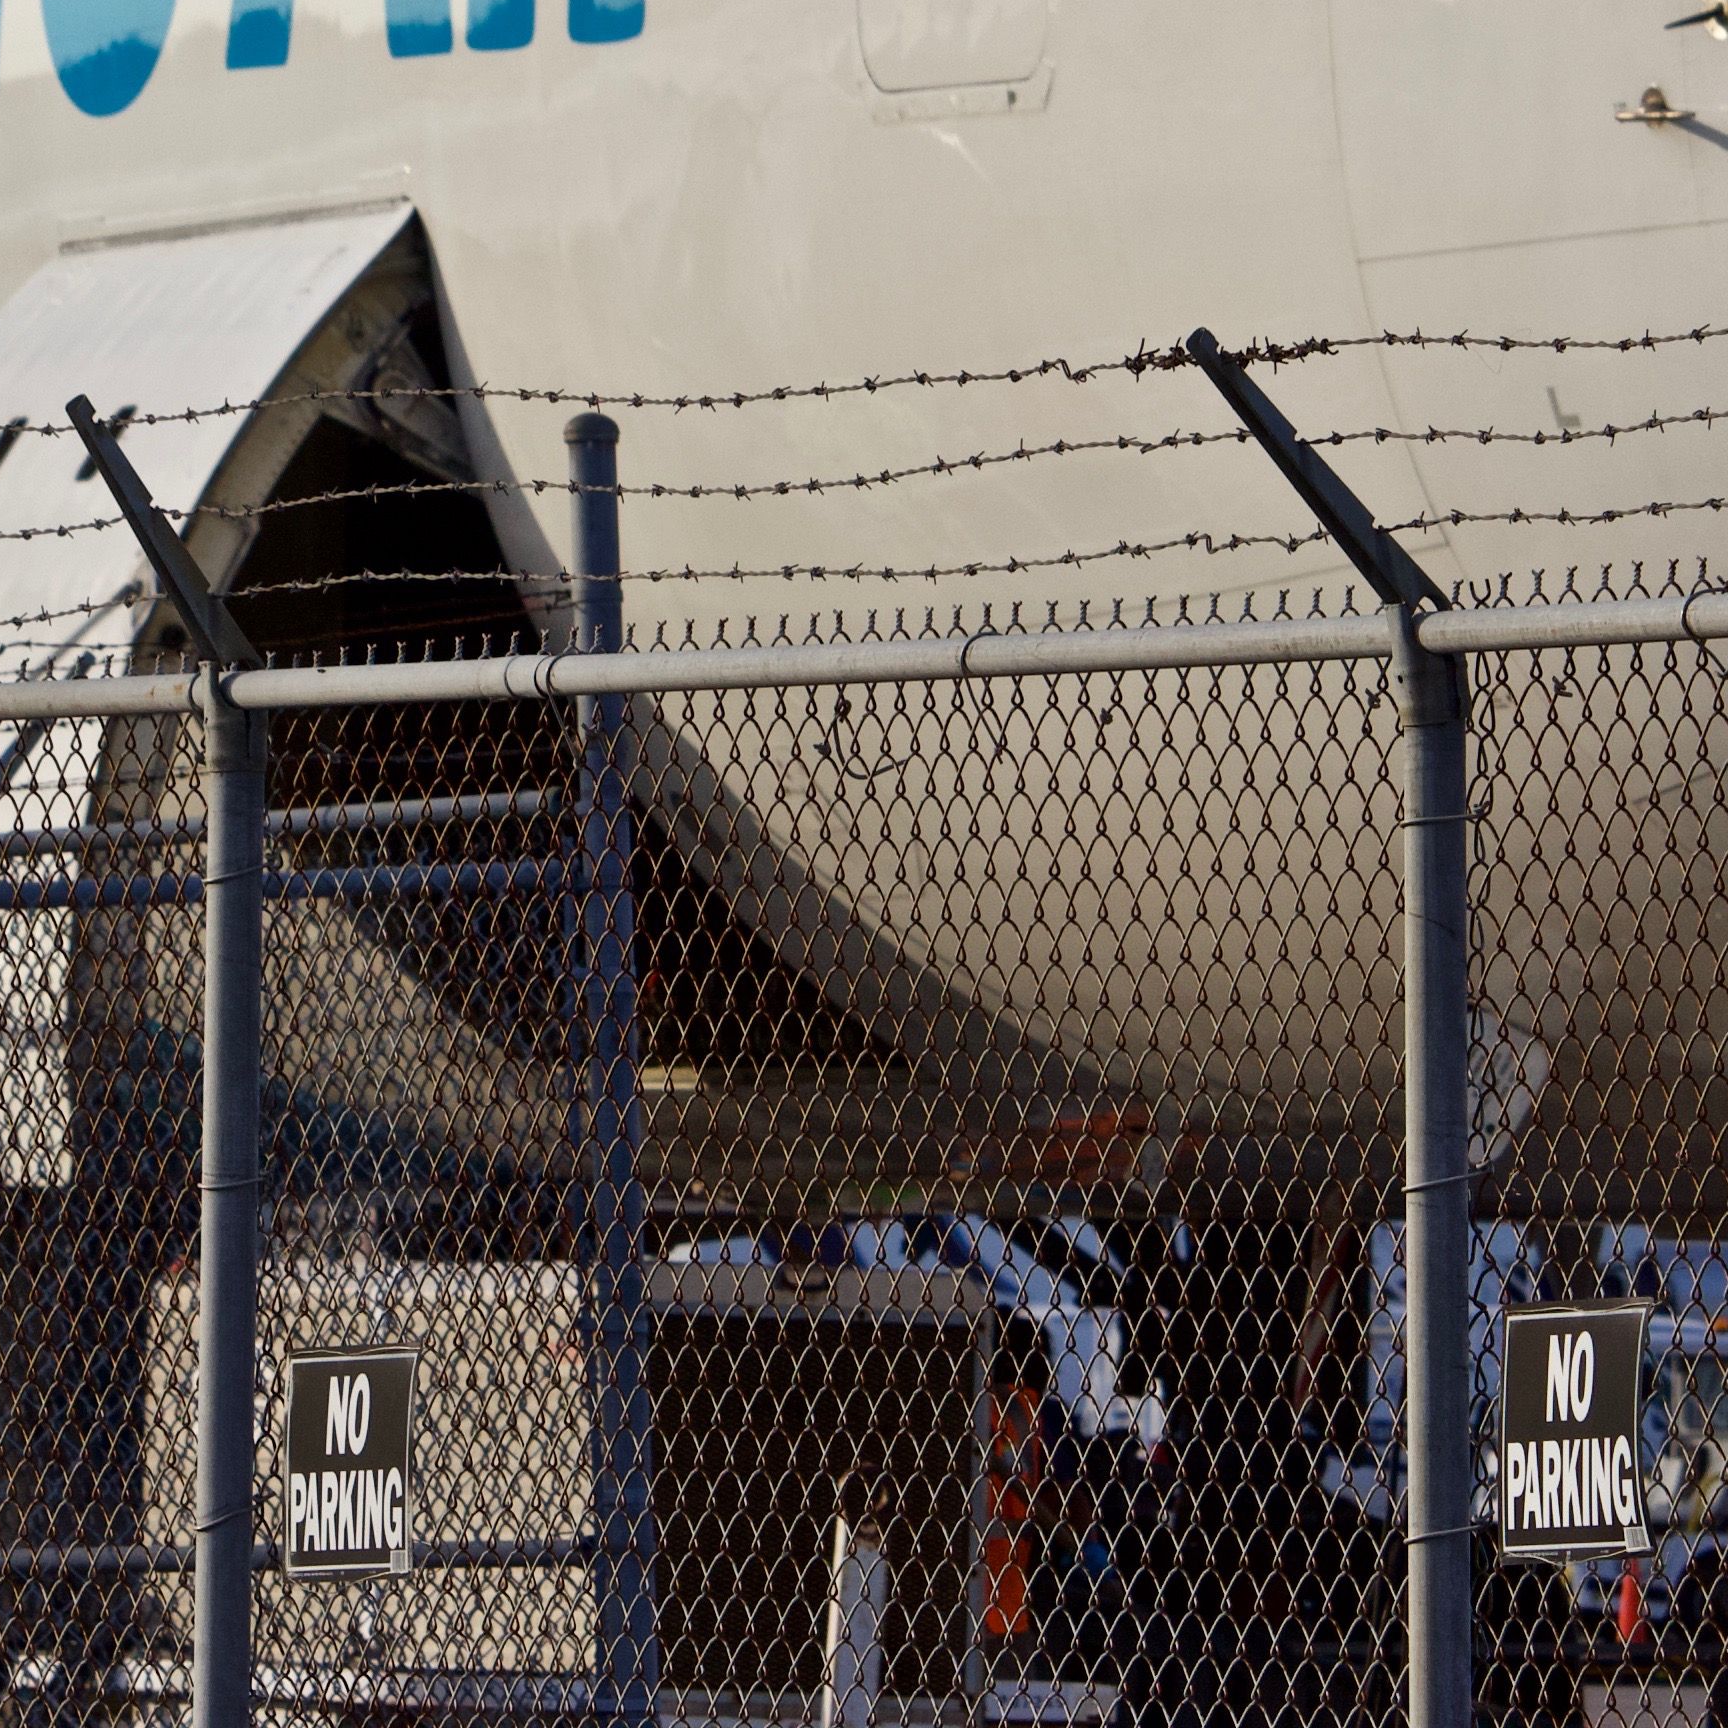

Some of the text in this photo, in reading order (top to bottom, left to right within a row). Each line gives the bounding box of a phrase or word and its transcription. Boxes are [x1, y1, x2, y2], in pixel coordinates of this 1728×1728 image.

[325, 1373, 371, 1456] NO
[1545, 1330, 1594, 1422] NO
[290, 1466, 403, 1553] PARKING
[1507, 1434, 1638, 1531] PARKING
